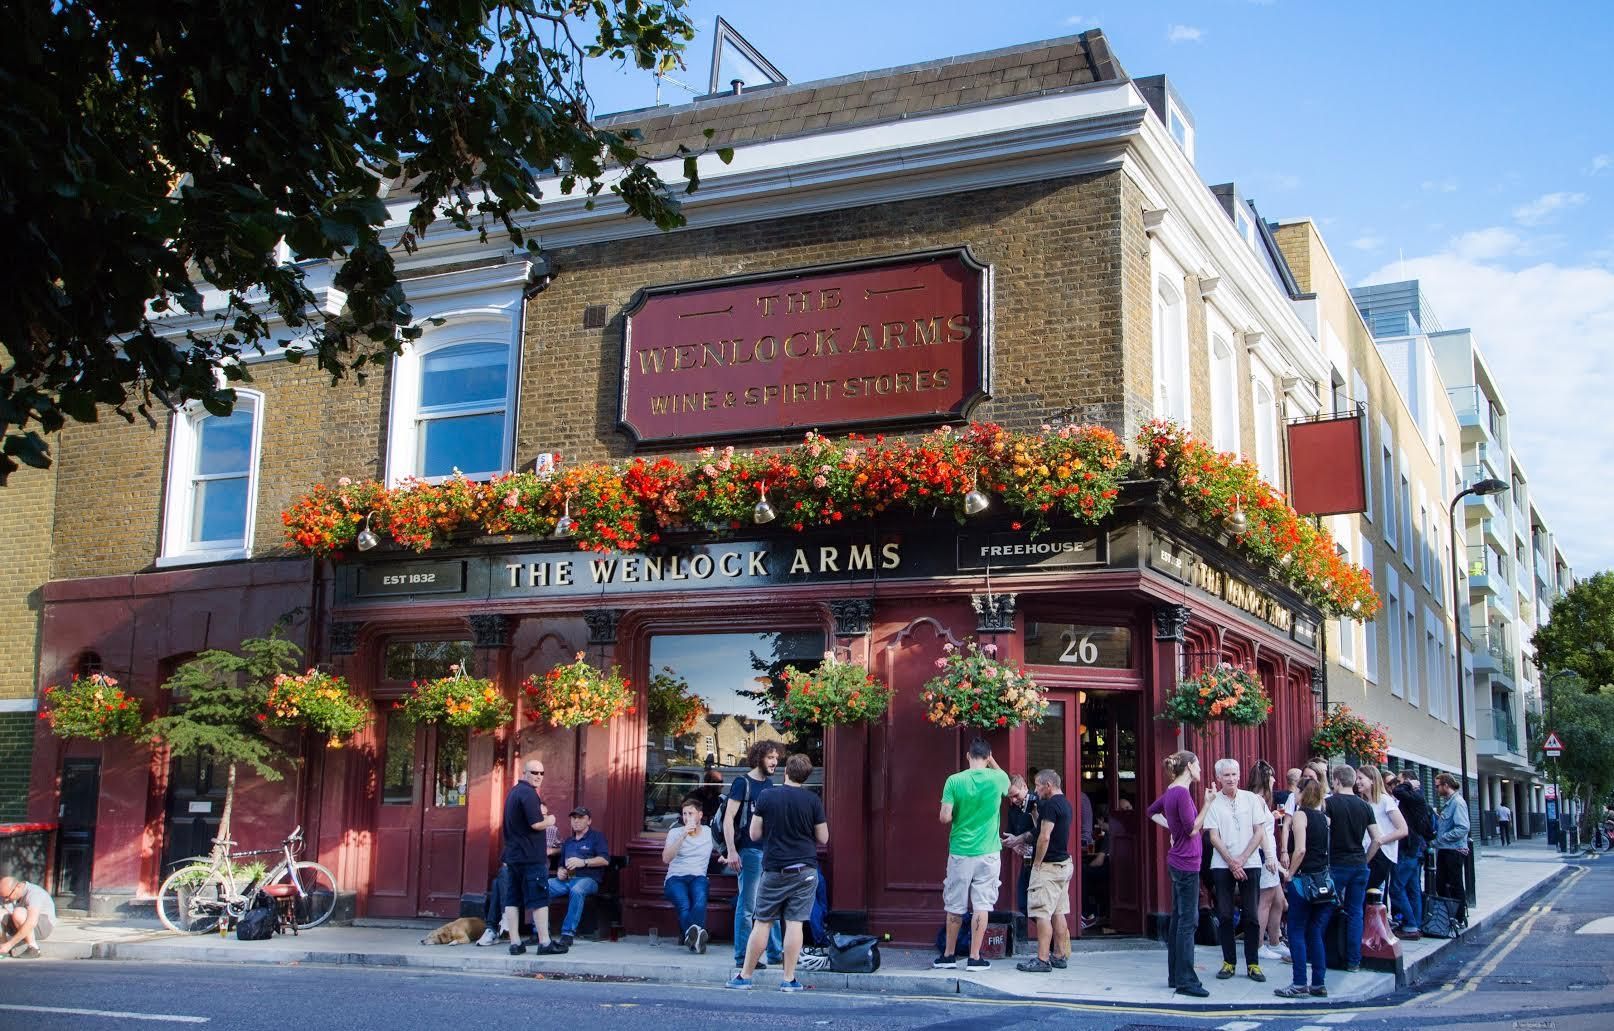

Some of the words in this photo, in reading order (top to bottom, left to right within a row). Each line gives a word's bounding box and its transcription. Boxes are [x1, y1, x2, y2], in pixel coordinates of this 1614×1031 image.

[756, 287, 843, 319] THE
[637, 328, 841, 375] WENLOCK
[850, 313, 972, 352] ARMS
[650, 390, 719, 416] WINE
[722, 391, 737, 408] &
[743, 380, 837, 407] SPIRIT
[843, 369, 951, 398] STORES
[507, 560, 574, 588] THE
[588, 550, 769, 584] WENLOCK
[789, 543, 902, 575] ARMS
[981, 541, 1084, 557] FREEHOUSE
[383, 575, 407, 585] EST
[408, 574, 436, 584] 1832
[1059, 629, 1098, 663] 26
[988, 935, 1004, 946] FIRE
